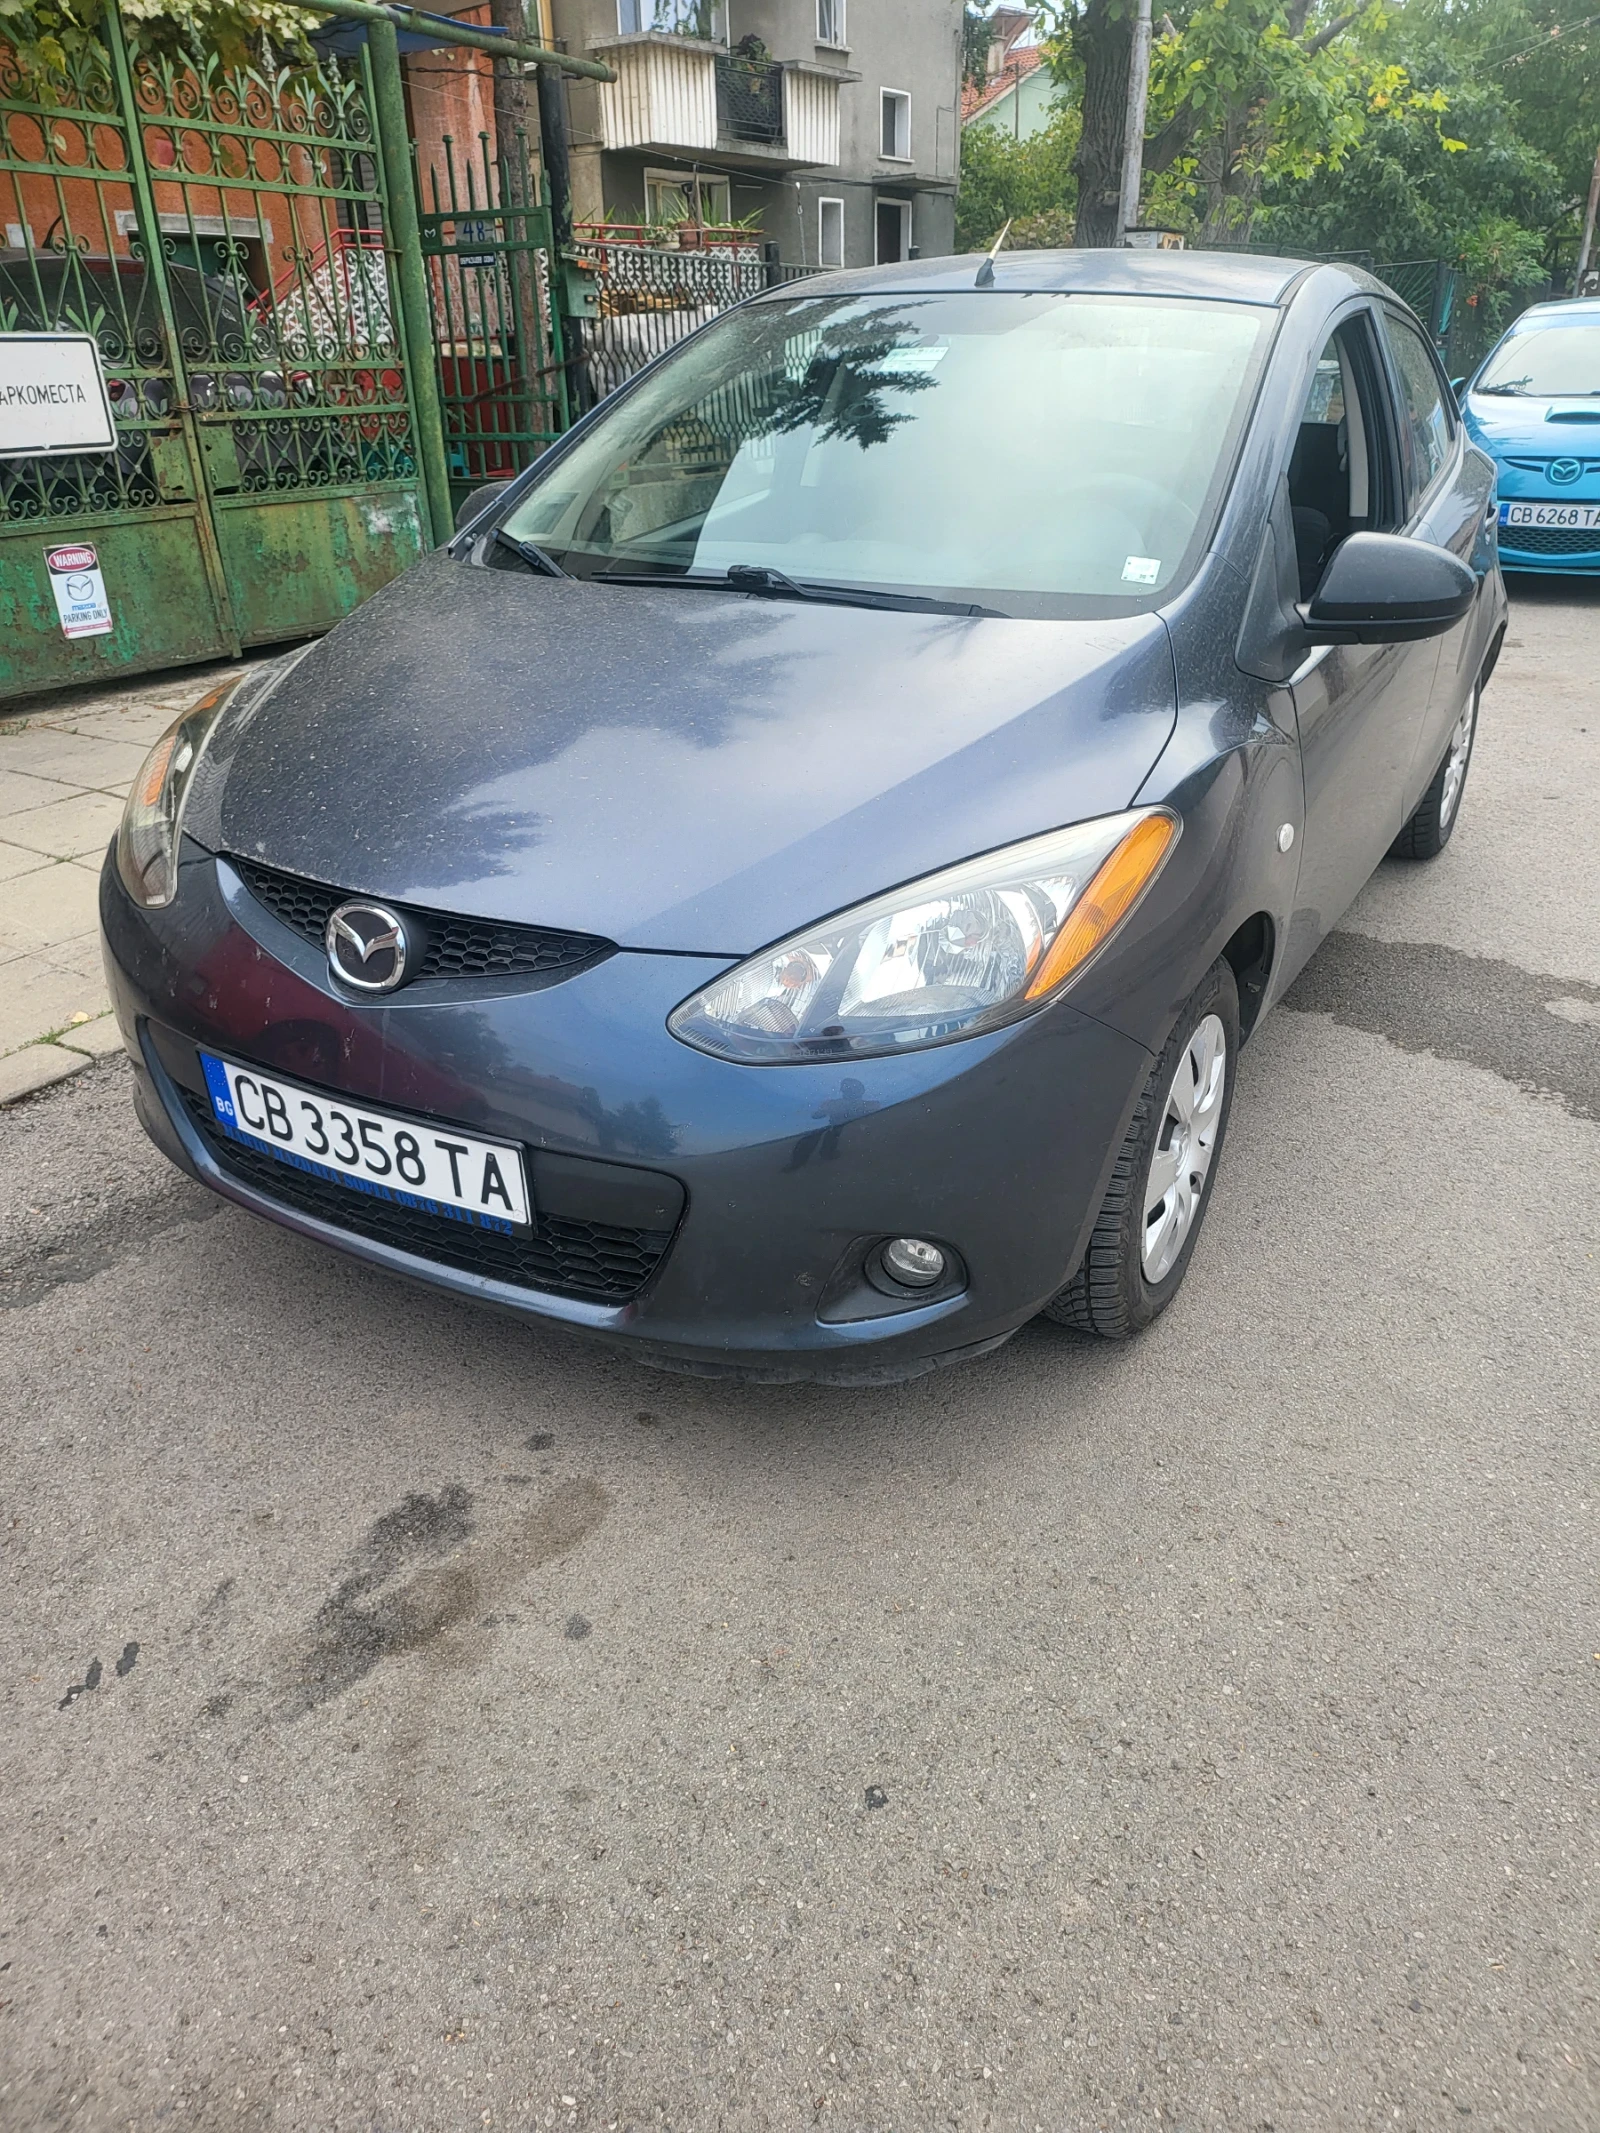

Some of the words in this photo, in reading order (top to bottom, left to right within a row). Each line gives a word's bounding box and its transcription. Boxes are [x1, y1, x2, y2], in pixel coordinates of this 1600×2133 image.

[1511, 507, 1533, 523] CB
[1536, 508, 1578, 525] 6268
[54, 552, 92, 567] WARNING
[63, 611, 92, 623] PARKING
[93, 608, 107, 619] ONLY
[215, 1096, 233, 1116] BG
[235, 1074, 293, 1141] CB
[301, 1101, 426, 1186] 3358
[435, 1139, 513, 1211] TA
[395, 1191, 439, 1214] 0876
[443, 1204, 474, 1224] 311
[479, 1214, 513, 1236] 872
